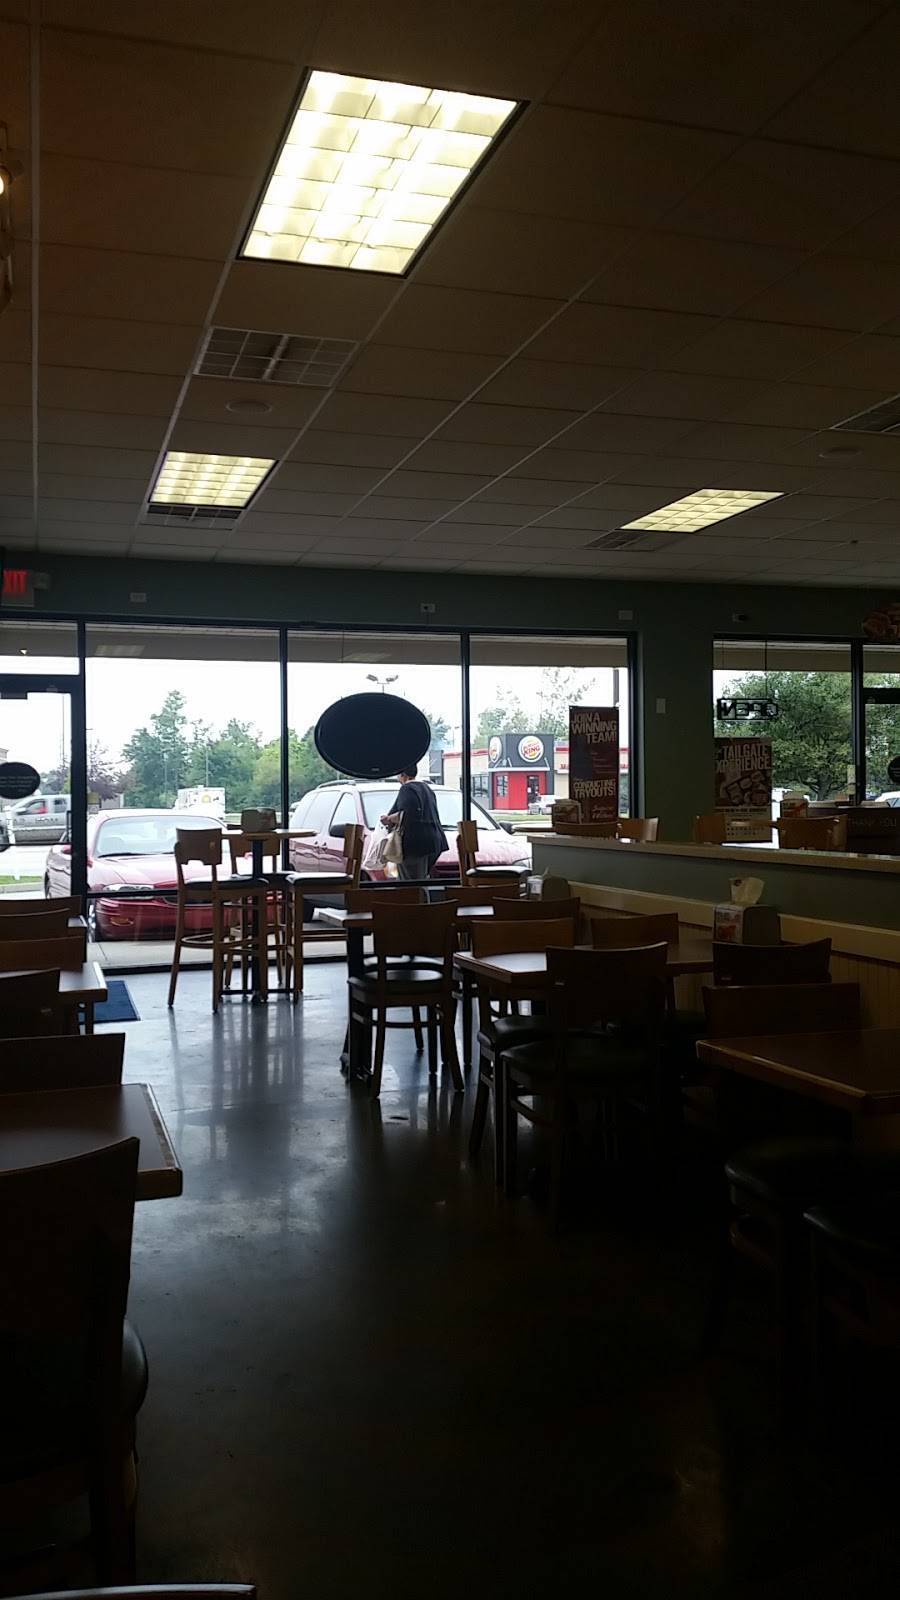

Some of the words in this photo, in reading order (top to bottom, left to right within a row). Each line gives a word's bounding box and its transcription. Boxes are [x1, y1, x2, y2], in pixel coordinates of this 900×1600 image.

[3, 568, 28, 592] XIT
[571, 712, 592, 724] JOIN
[593, 711, 601, 721] A
[571, 720, 617, 736] WINNING
[586, 731, 617, 744] TEAM!
[523, 745, 541, 755] KING
[721, 743, 769, 760] TAILGATE
[716, 756, 771, 773] XPERIENCE
[573, 779, 616, 790] CONDUCTING
[575, 786, 616, 799] TRYOUTS!
